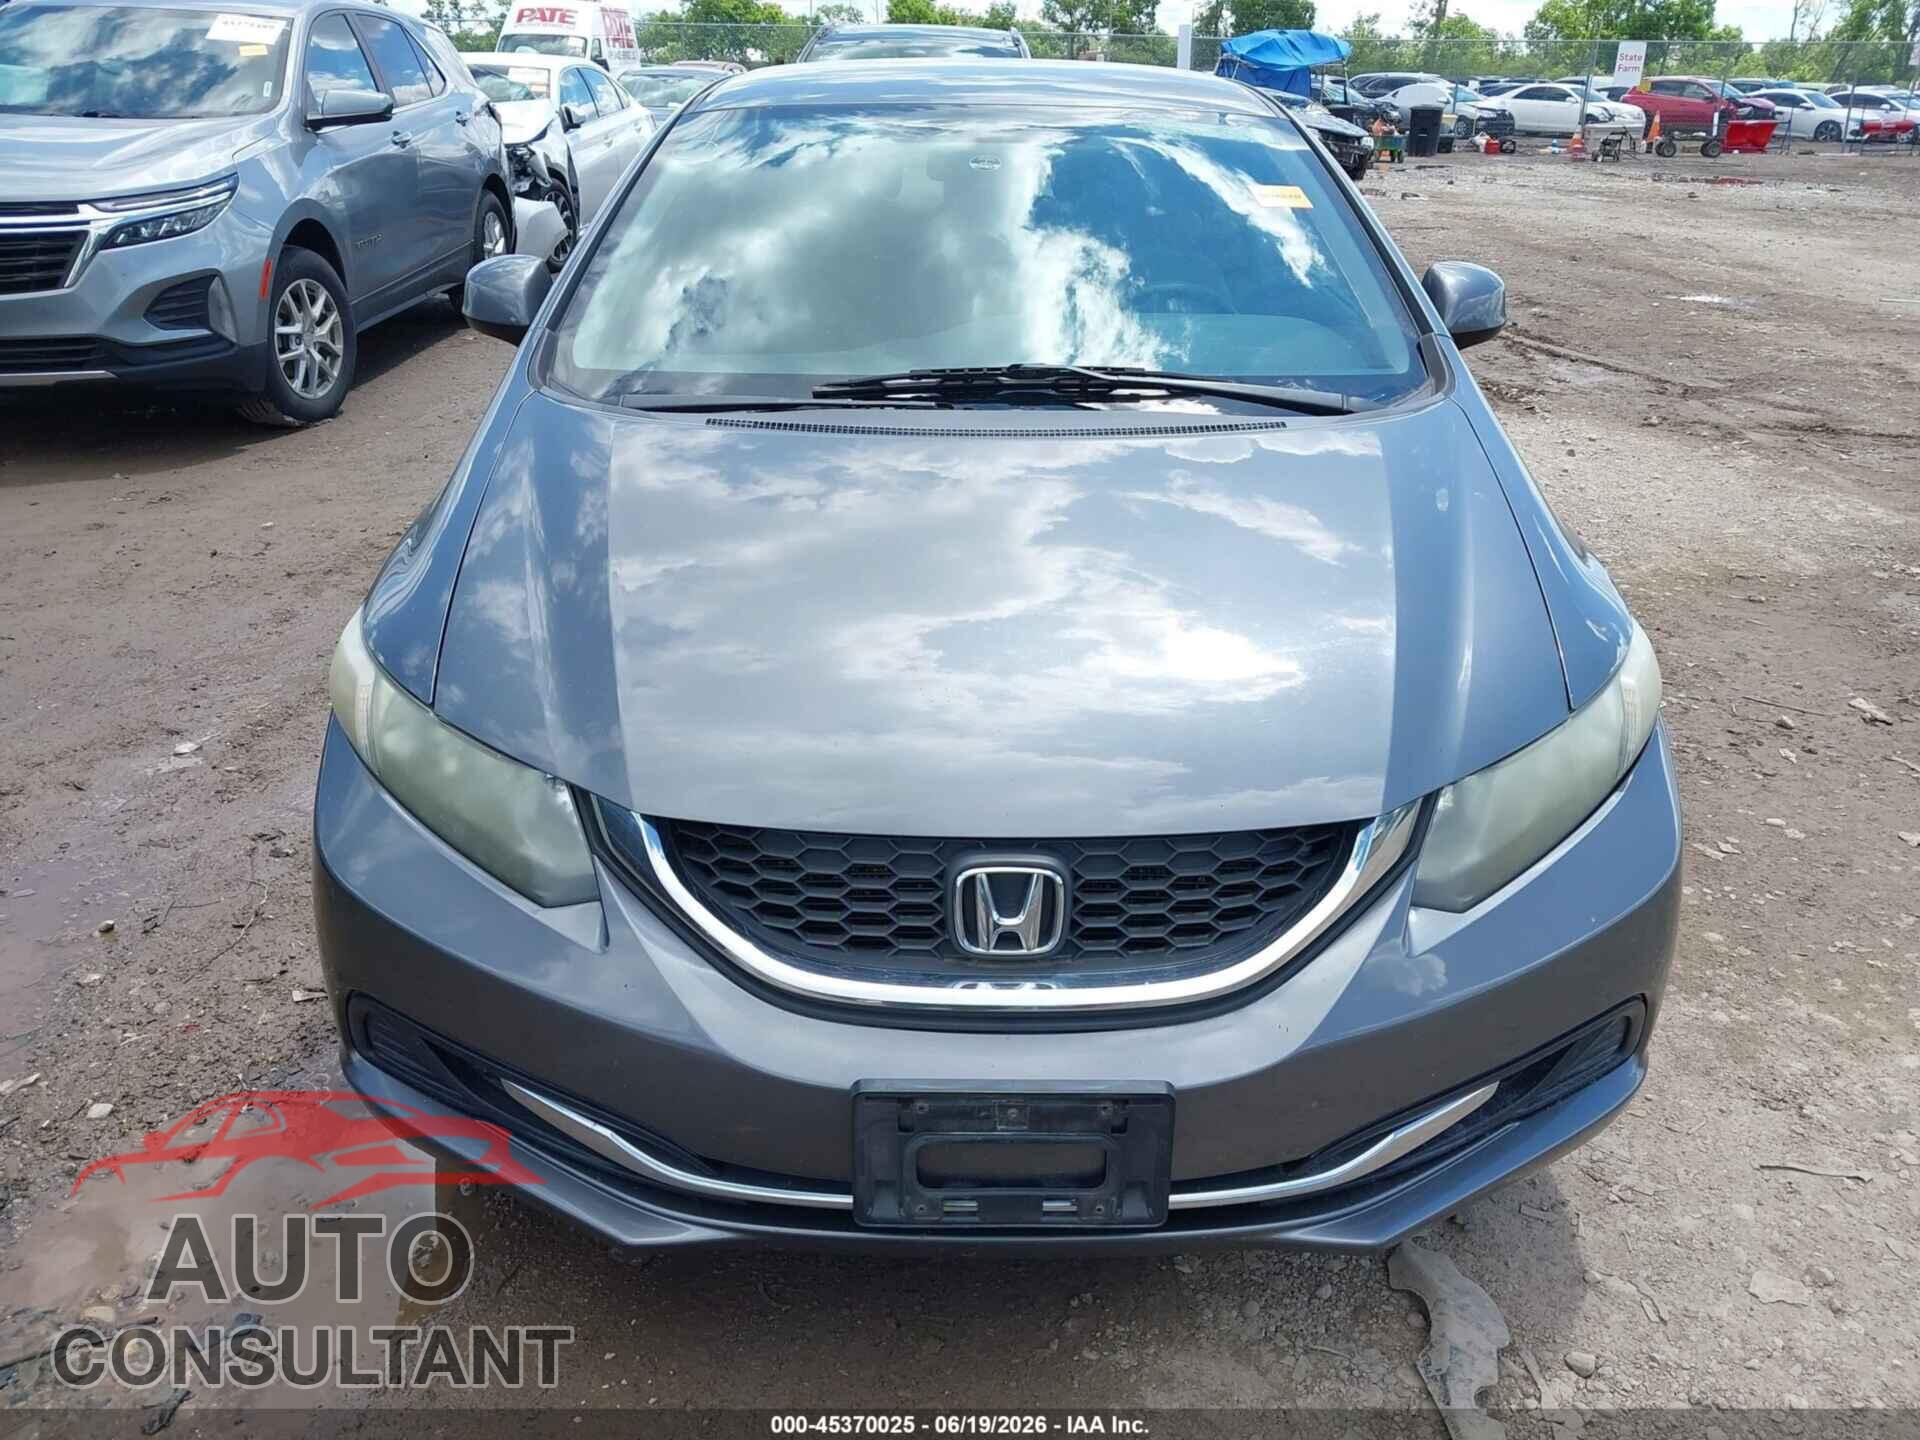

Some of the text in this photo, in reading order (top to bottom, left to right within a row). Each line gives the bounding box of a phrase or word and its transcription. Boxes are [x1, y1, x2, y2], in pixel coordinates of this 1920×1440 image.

[516, 7, 578, 24] PATE
[1619, 52, 1643, 62] State
[1617, 63, 1641, 72] Farm
